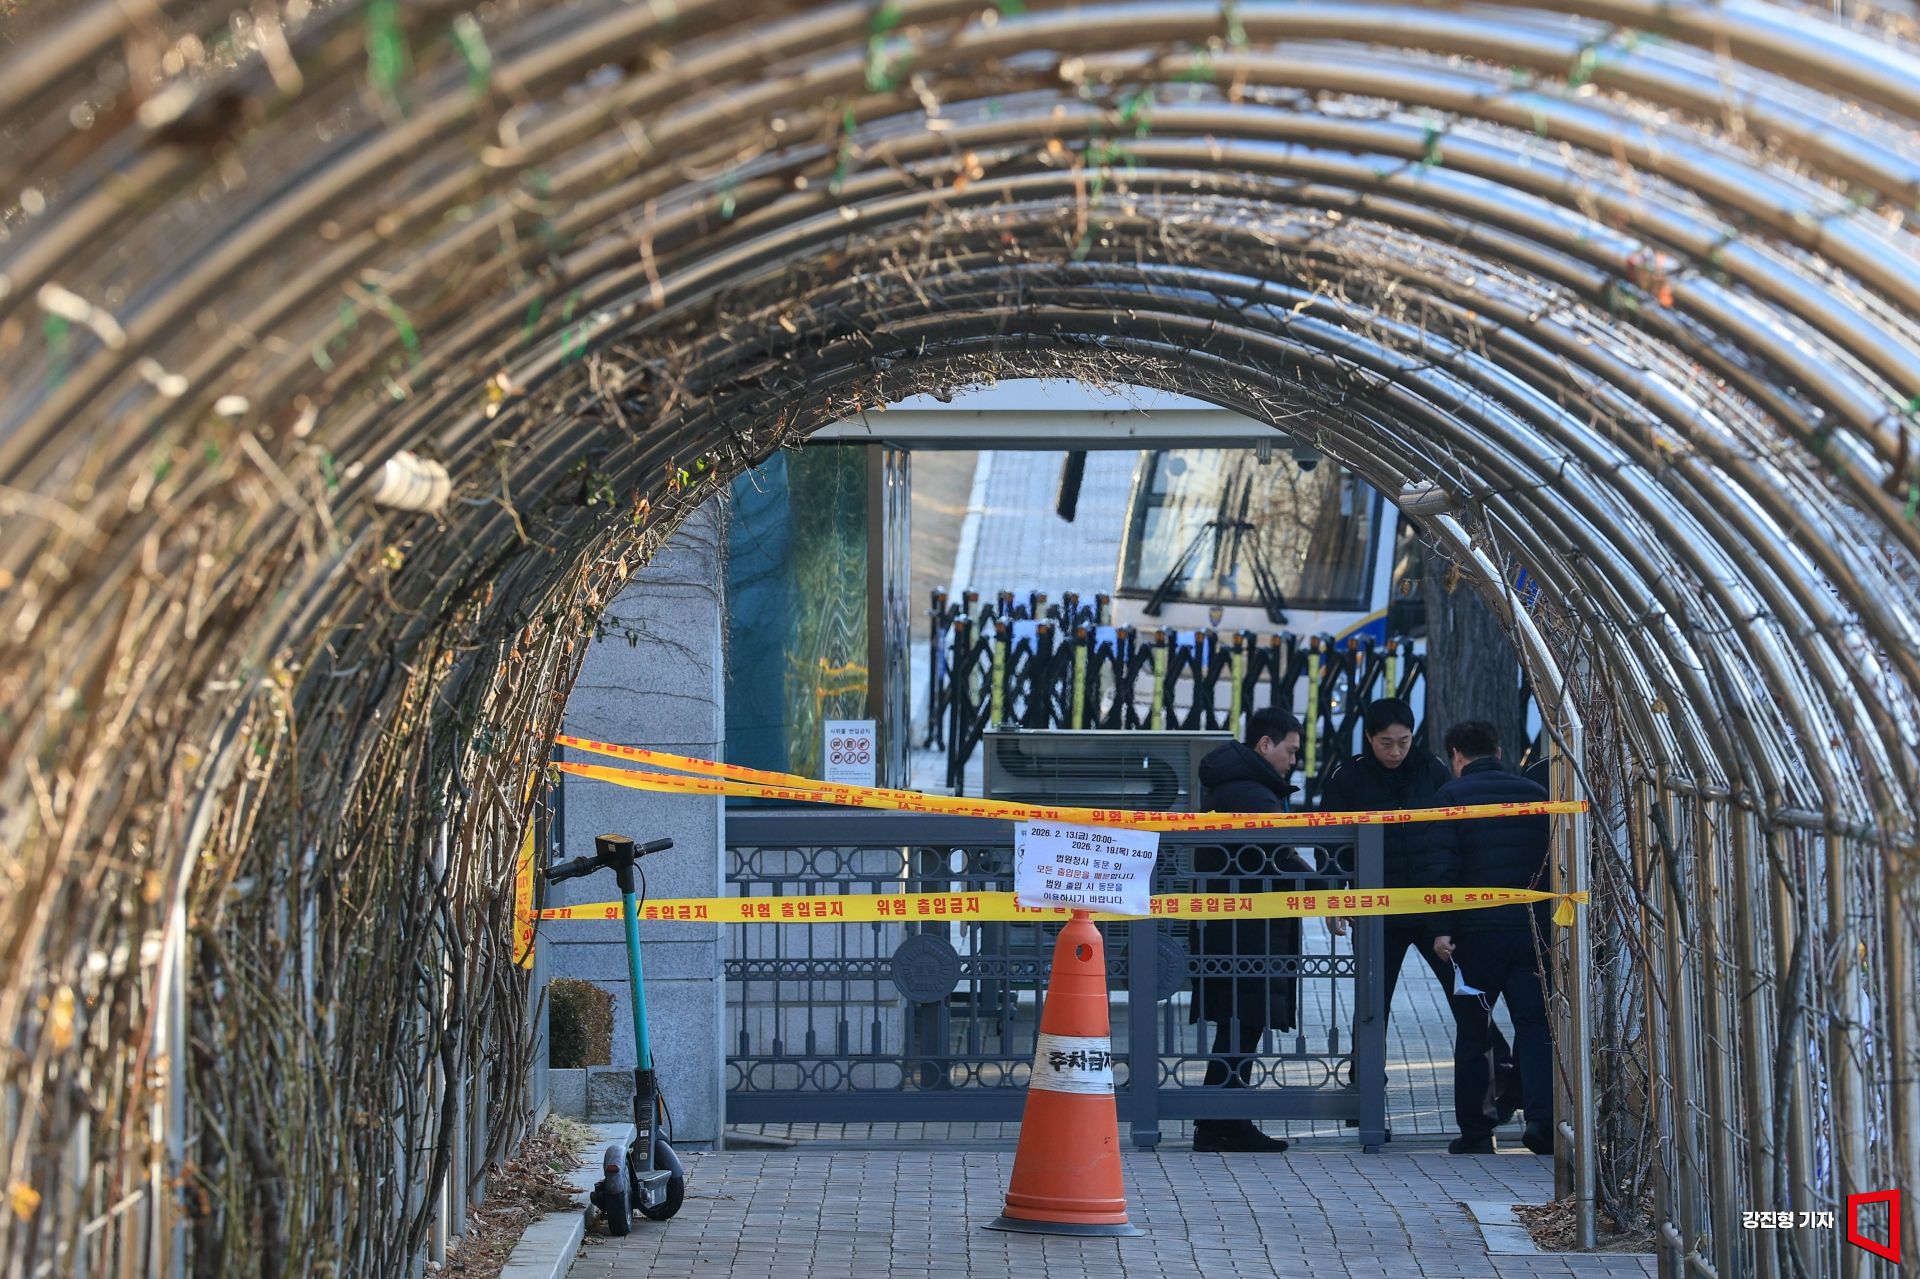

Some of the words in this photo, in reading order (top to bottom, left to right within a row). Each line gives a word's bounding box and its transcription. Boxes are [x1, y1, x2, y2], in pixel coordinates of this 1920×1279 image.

[1031, 828, 1051, 837] 2026.
[1055, 830, 1062, 838] 2.
[1072, 841, 1092, 851] 2026.
[1095, 844, 1102, 852] 2.
[1132, 849, 1153, 860] 24:00
[1036, 864, 1054, 875] 모든
[1057, 867, 1090, 880] 출입문을
[1093, 859, 1110, 870] 동문
[1113, 862, 1122, 871] 외
[1045, 879, 1062, 889] 법원
[1066, 881, 1082, 890] 출입
[1086, 882, 1094, 891] 시
[1098, 883, 1123, 892] 동문을
[876, 899, 907, 916] 위험
[917, 897, 980, 915] 출입금지
[1043, 892, 1085, 904] 이용하시기
[1089, 894, 1124, 905] 바랍니다.
[1150, 898, 1179, 914] 위험
[1190, 897, 1253, 913] 출입금지
[1286, 896, 1316, 910] 위험
[1327, 895, 1390, 909] 출입금지
[645, 904, 708, 920] 출입금지
[740, 903, 771, 918] 위험
[781, 901, 844, 918] 출입금지
